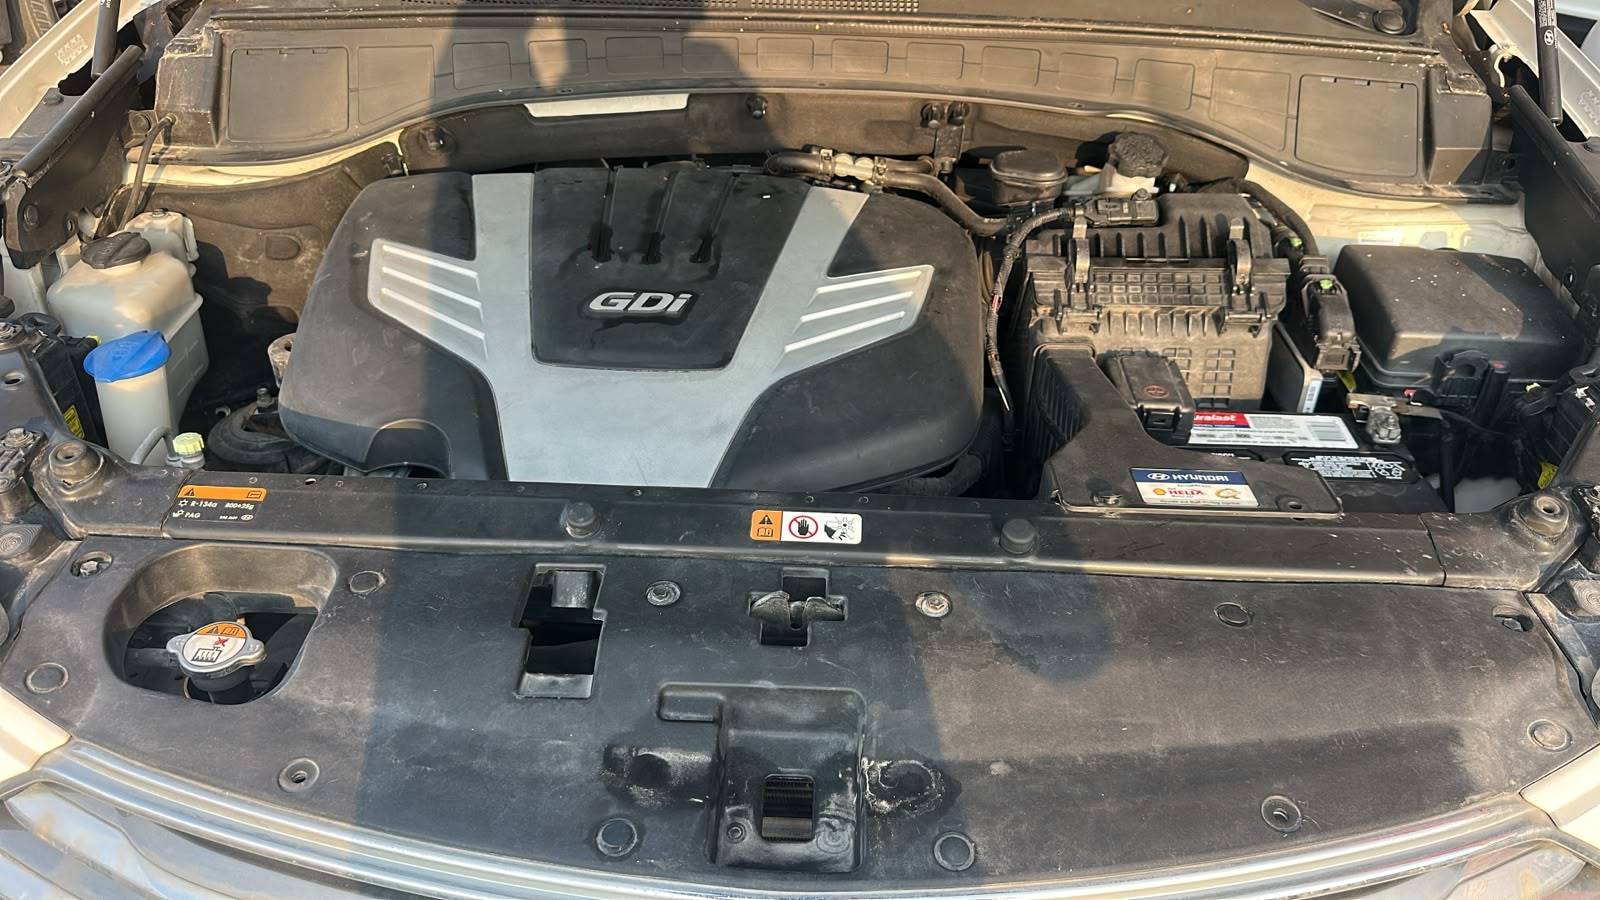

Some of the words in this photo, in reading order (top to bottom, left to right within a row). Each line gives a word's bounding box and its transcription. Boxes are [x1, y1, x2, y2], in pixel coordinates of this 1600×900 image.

[589, 291, 693, 313] GDi
[1193, 414, 1239, 422] uralast
[1171, 473, 1230, 482] HYUNDAI
[1167, 488, 1205, 496] HELIX
